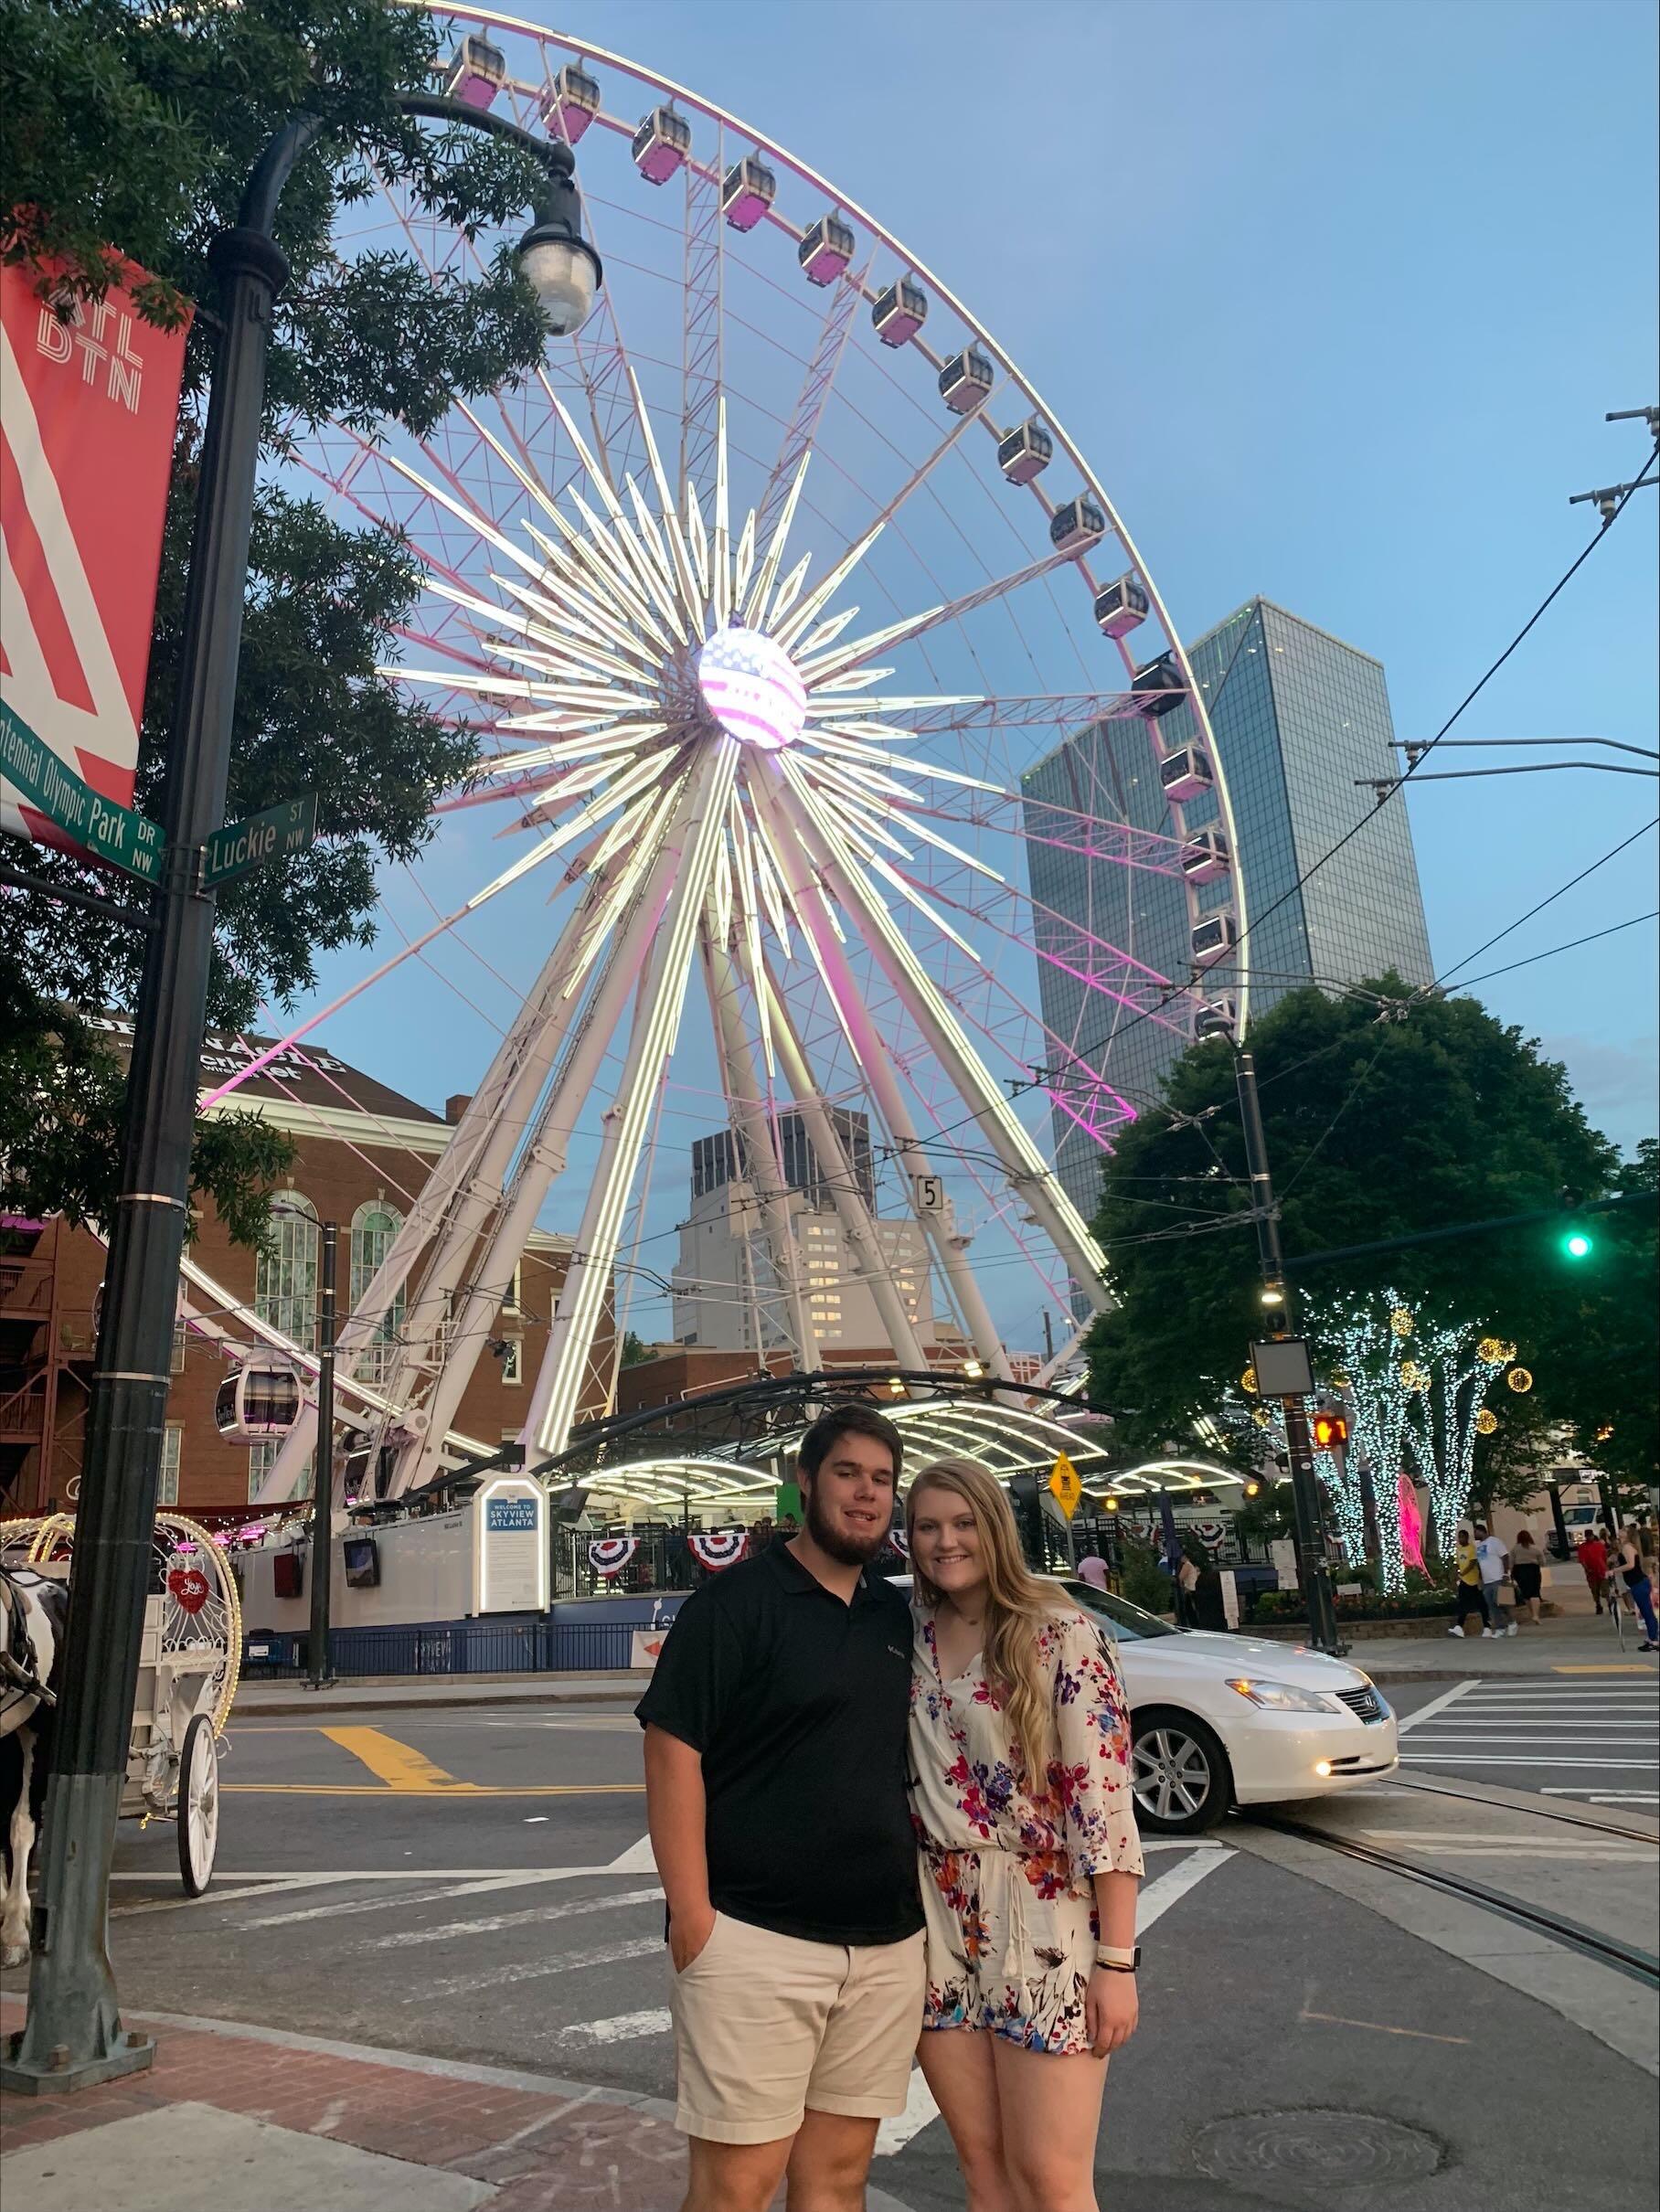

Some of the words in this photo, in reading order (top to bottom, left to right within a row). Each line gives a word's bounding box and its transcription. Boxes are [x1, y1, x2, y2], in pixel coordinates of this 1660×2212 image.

[37, 301, 142, 415] DTN
[43, 756, 86, 826] Olympic
[89, 797, 126, 848] Park
[138, 822, 156, 845] DR
[211, 821, 276, 873] Luckie
[290, 800, 304, 822] ST
[285, 827, 305, 850] NW
[132, 848, 154, 873] NW
[200, 1054, 302, 1080] cricet
[924, 1180, 935, 1206] 5
[490, 1510, 534, 1518] SKYVIEW
[491, 1518, 534, 1526] ATLANTA
